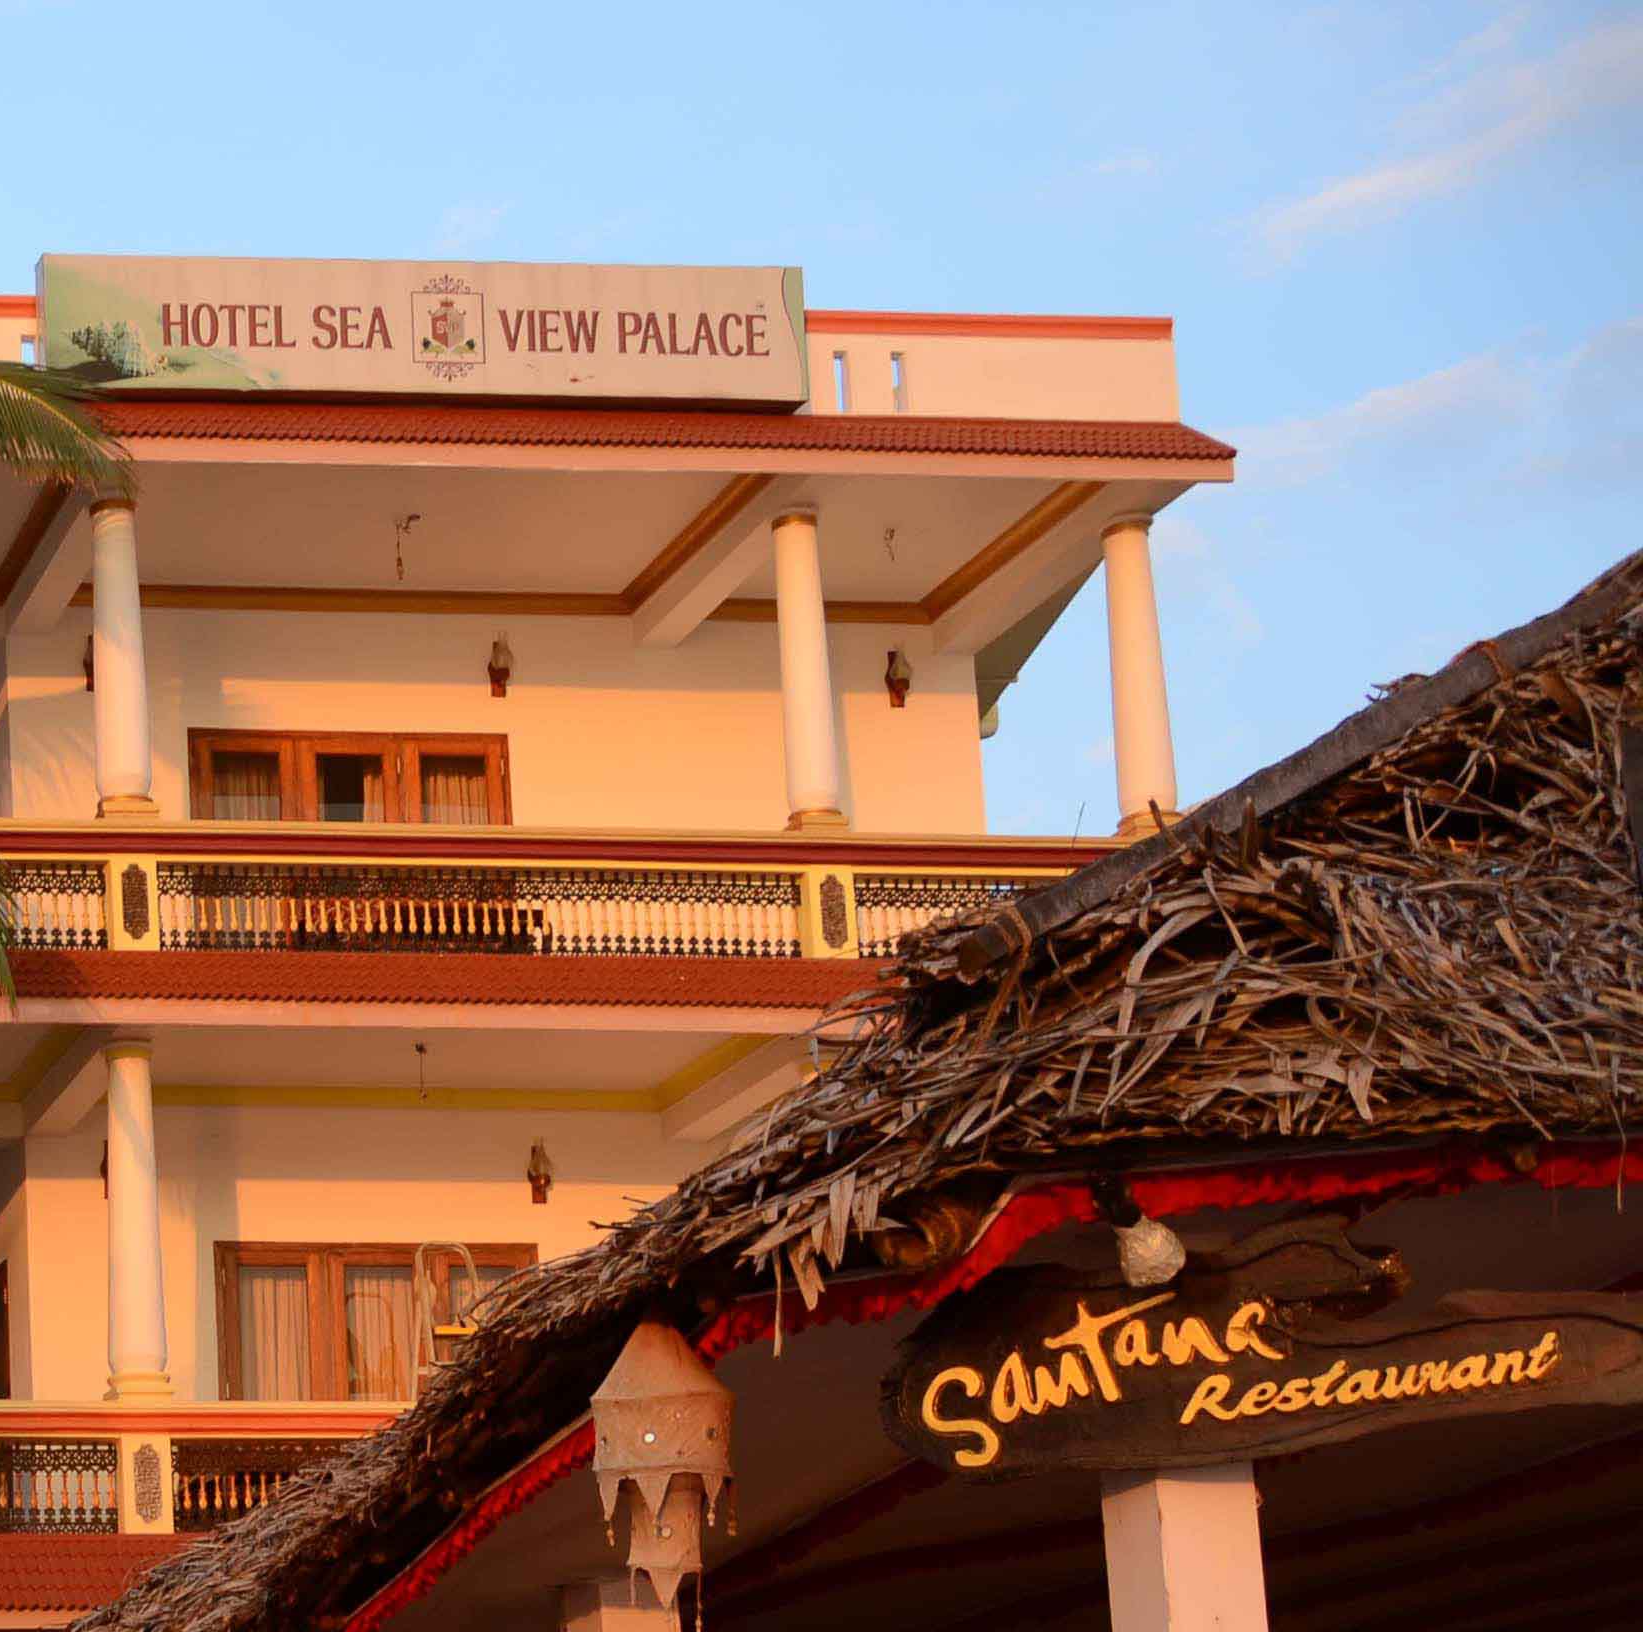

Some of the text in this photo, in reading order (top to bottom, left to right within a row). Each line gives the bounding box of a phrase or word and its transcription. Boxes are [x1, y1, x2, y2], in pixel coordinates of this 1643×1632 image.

[161, 303, 771, 357] HOTEL SEA VIEW PALACE
[921, 1291, 1285, 1468] Santana
[1180, 1330, 1559, 1424] Restaurant
